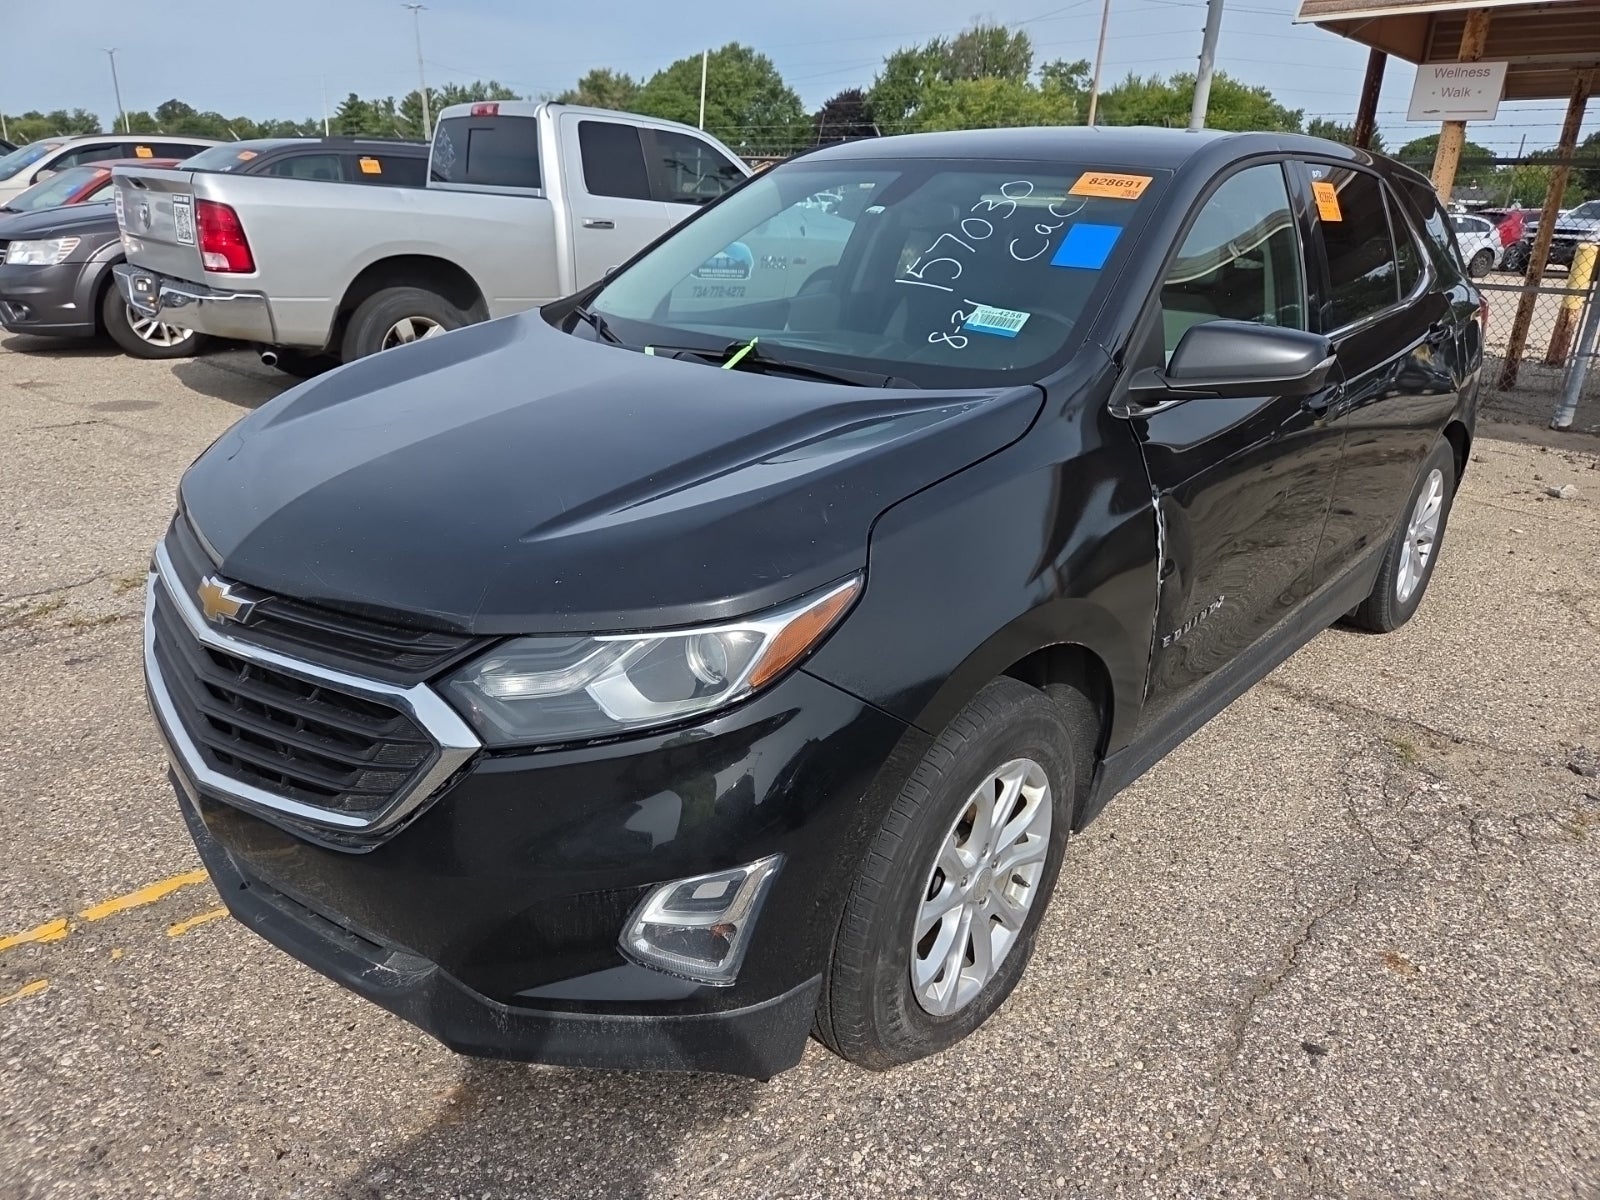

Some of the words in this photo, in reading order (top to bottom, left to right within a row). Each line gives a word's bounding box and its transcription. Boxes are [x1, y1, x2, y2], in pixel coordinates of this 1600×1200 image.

[1434, 67, 1491, 79] Wellness
[1441, 87, 1471, 98] Walk
[1088, 177, 1142, 189] 828691
